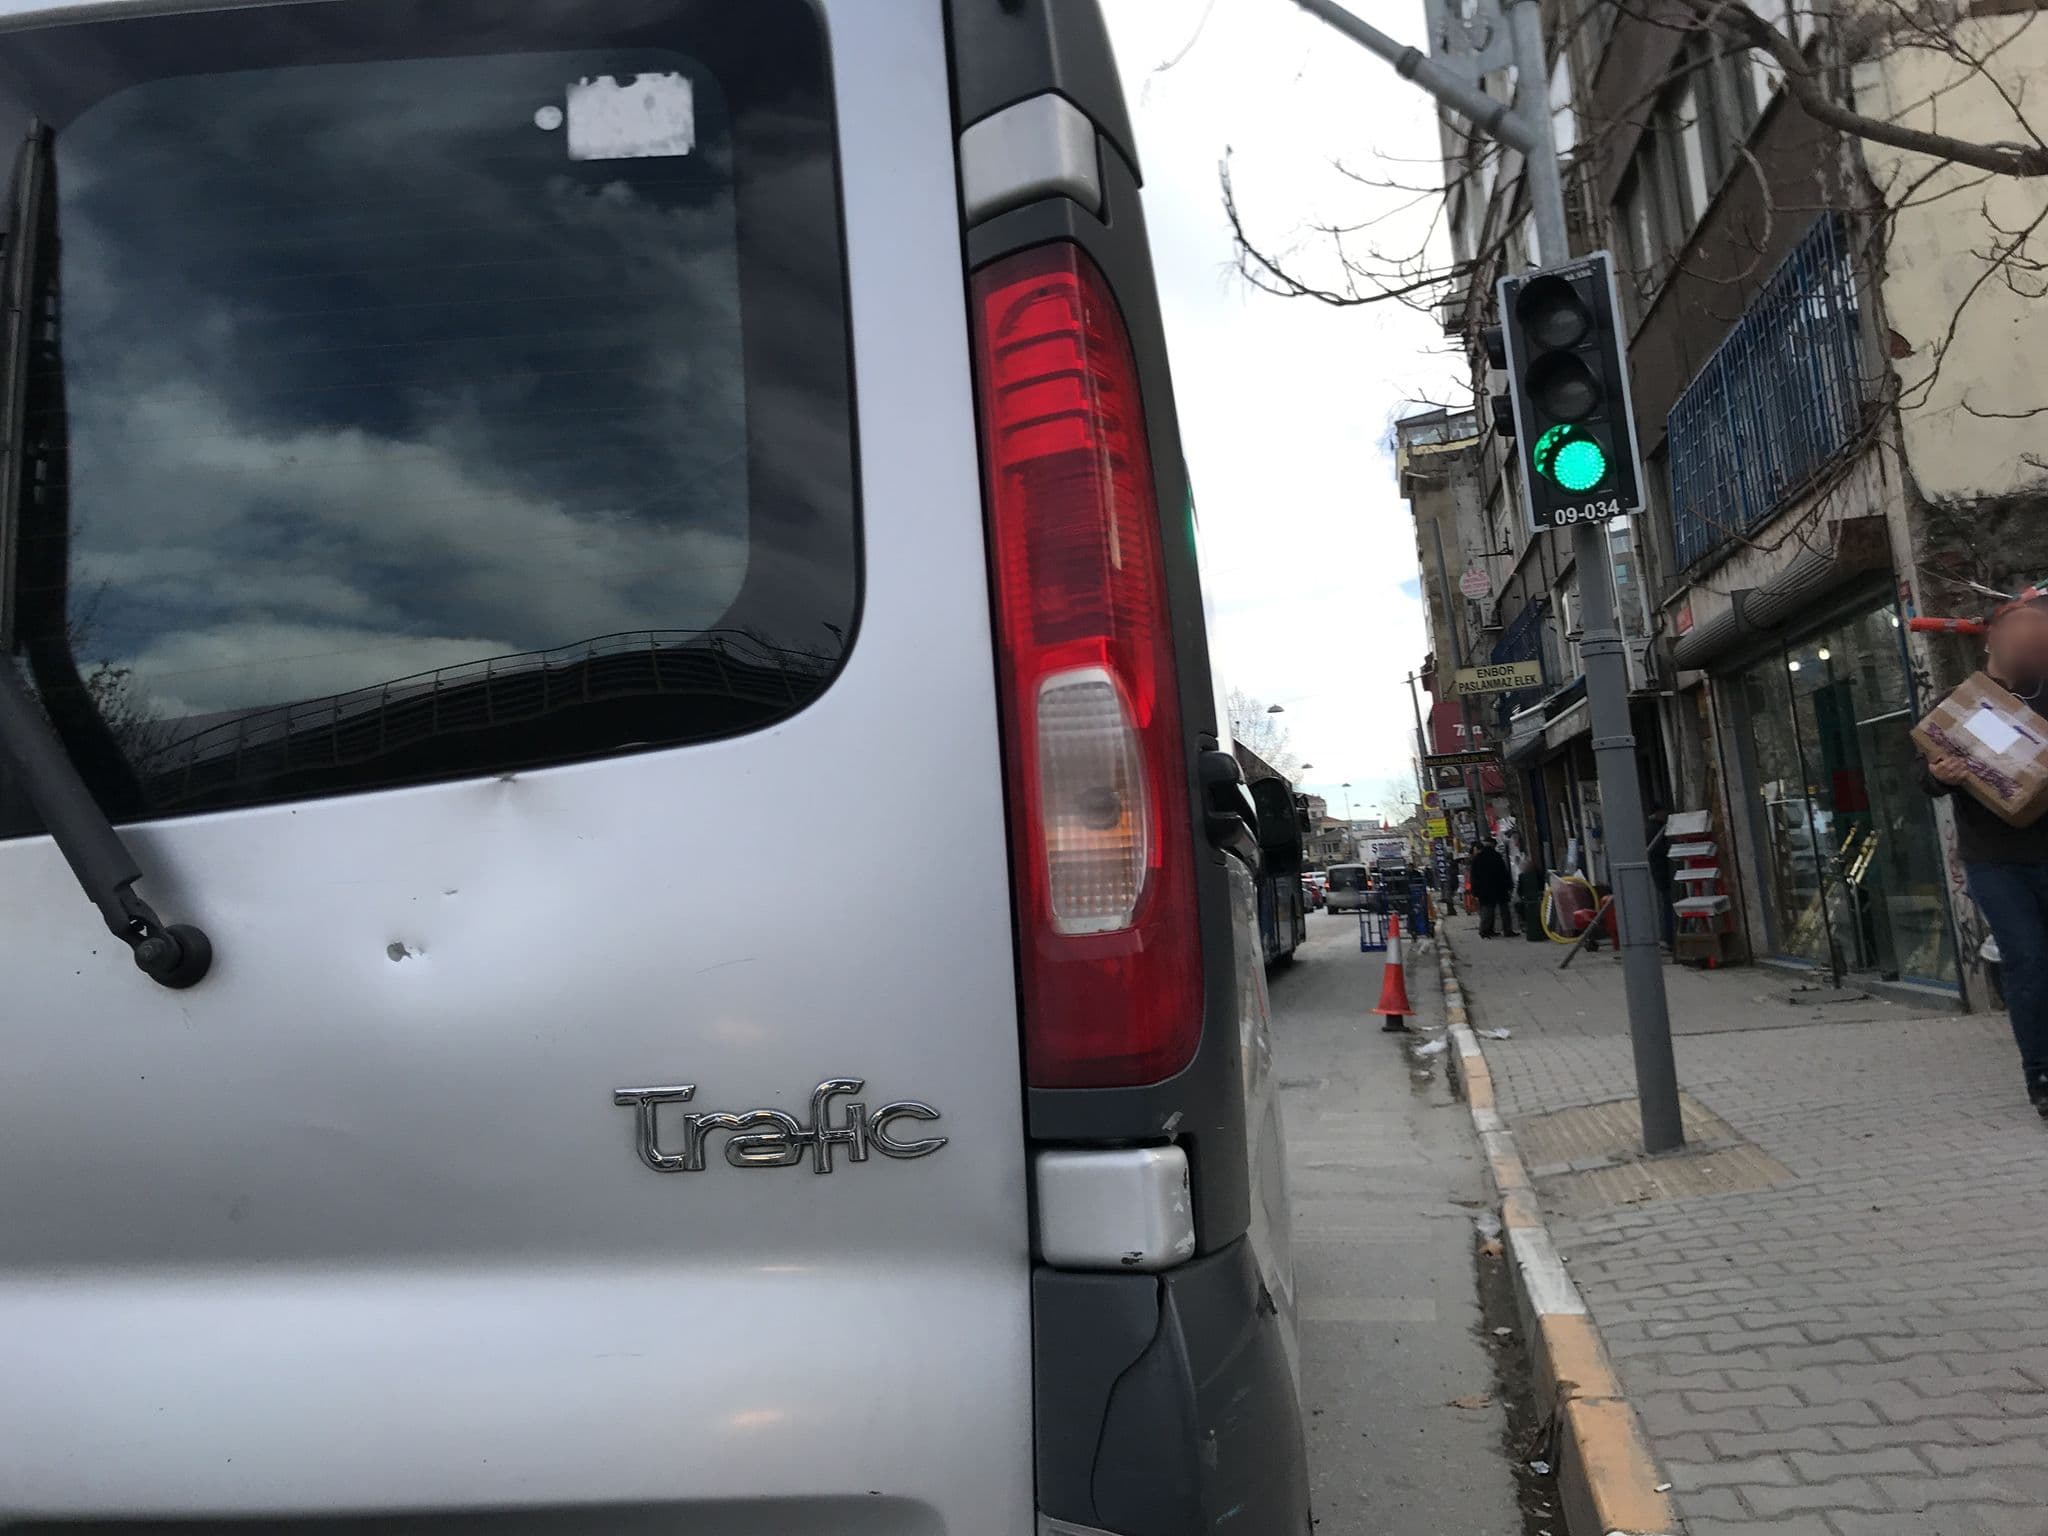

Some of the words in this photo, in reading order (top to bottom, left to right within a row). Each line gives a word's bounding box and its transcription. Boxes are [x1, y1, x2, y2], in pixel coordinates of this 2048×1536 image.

[1555, 499, 1620, 525] 09-034
[1477, 665, 1515, 678] ENBOR
[1459, 680, 1513, 692] PASLANMAZ
[1515, 674, 1537, 686] ELEK
[614, 1078, 949, 1174] Trafic
